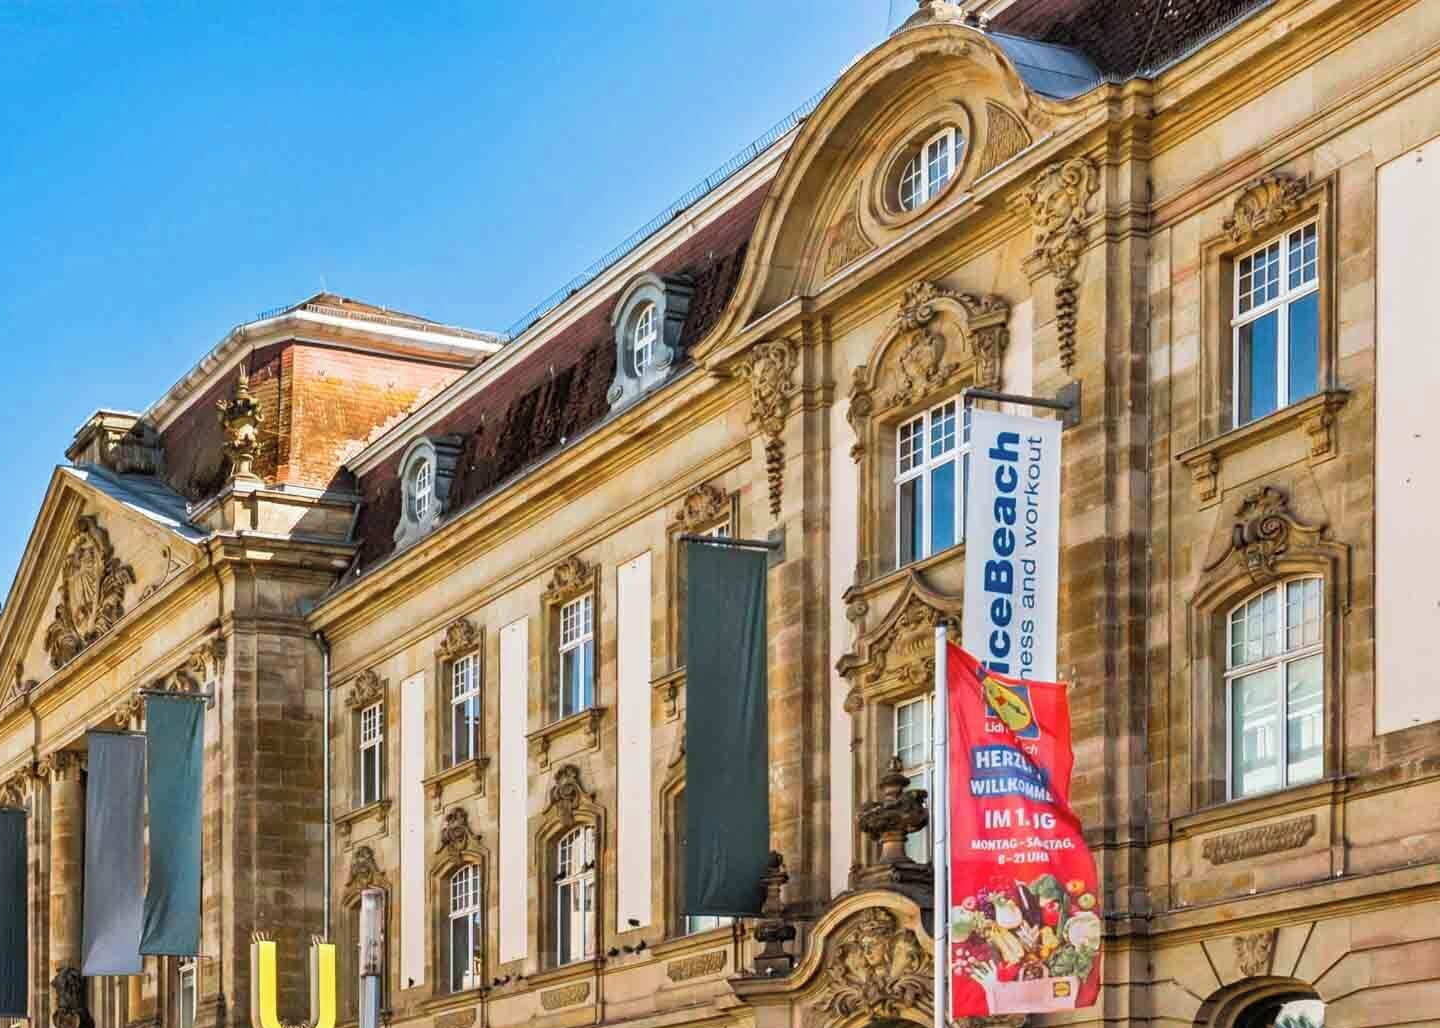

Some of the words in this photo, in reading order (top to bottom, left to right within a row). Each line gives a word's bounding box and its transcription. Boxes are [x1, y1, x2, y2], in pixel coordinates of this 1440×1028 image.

[1024, 436, 1043, 548] workout
[1021, 558, 1037, 609] and
[985, 808, 1011, 829] IM
